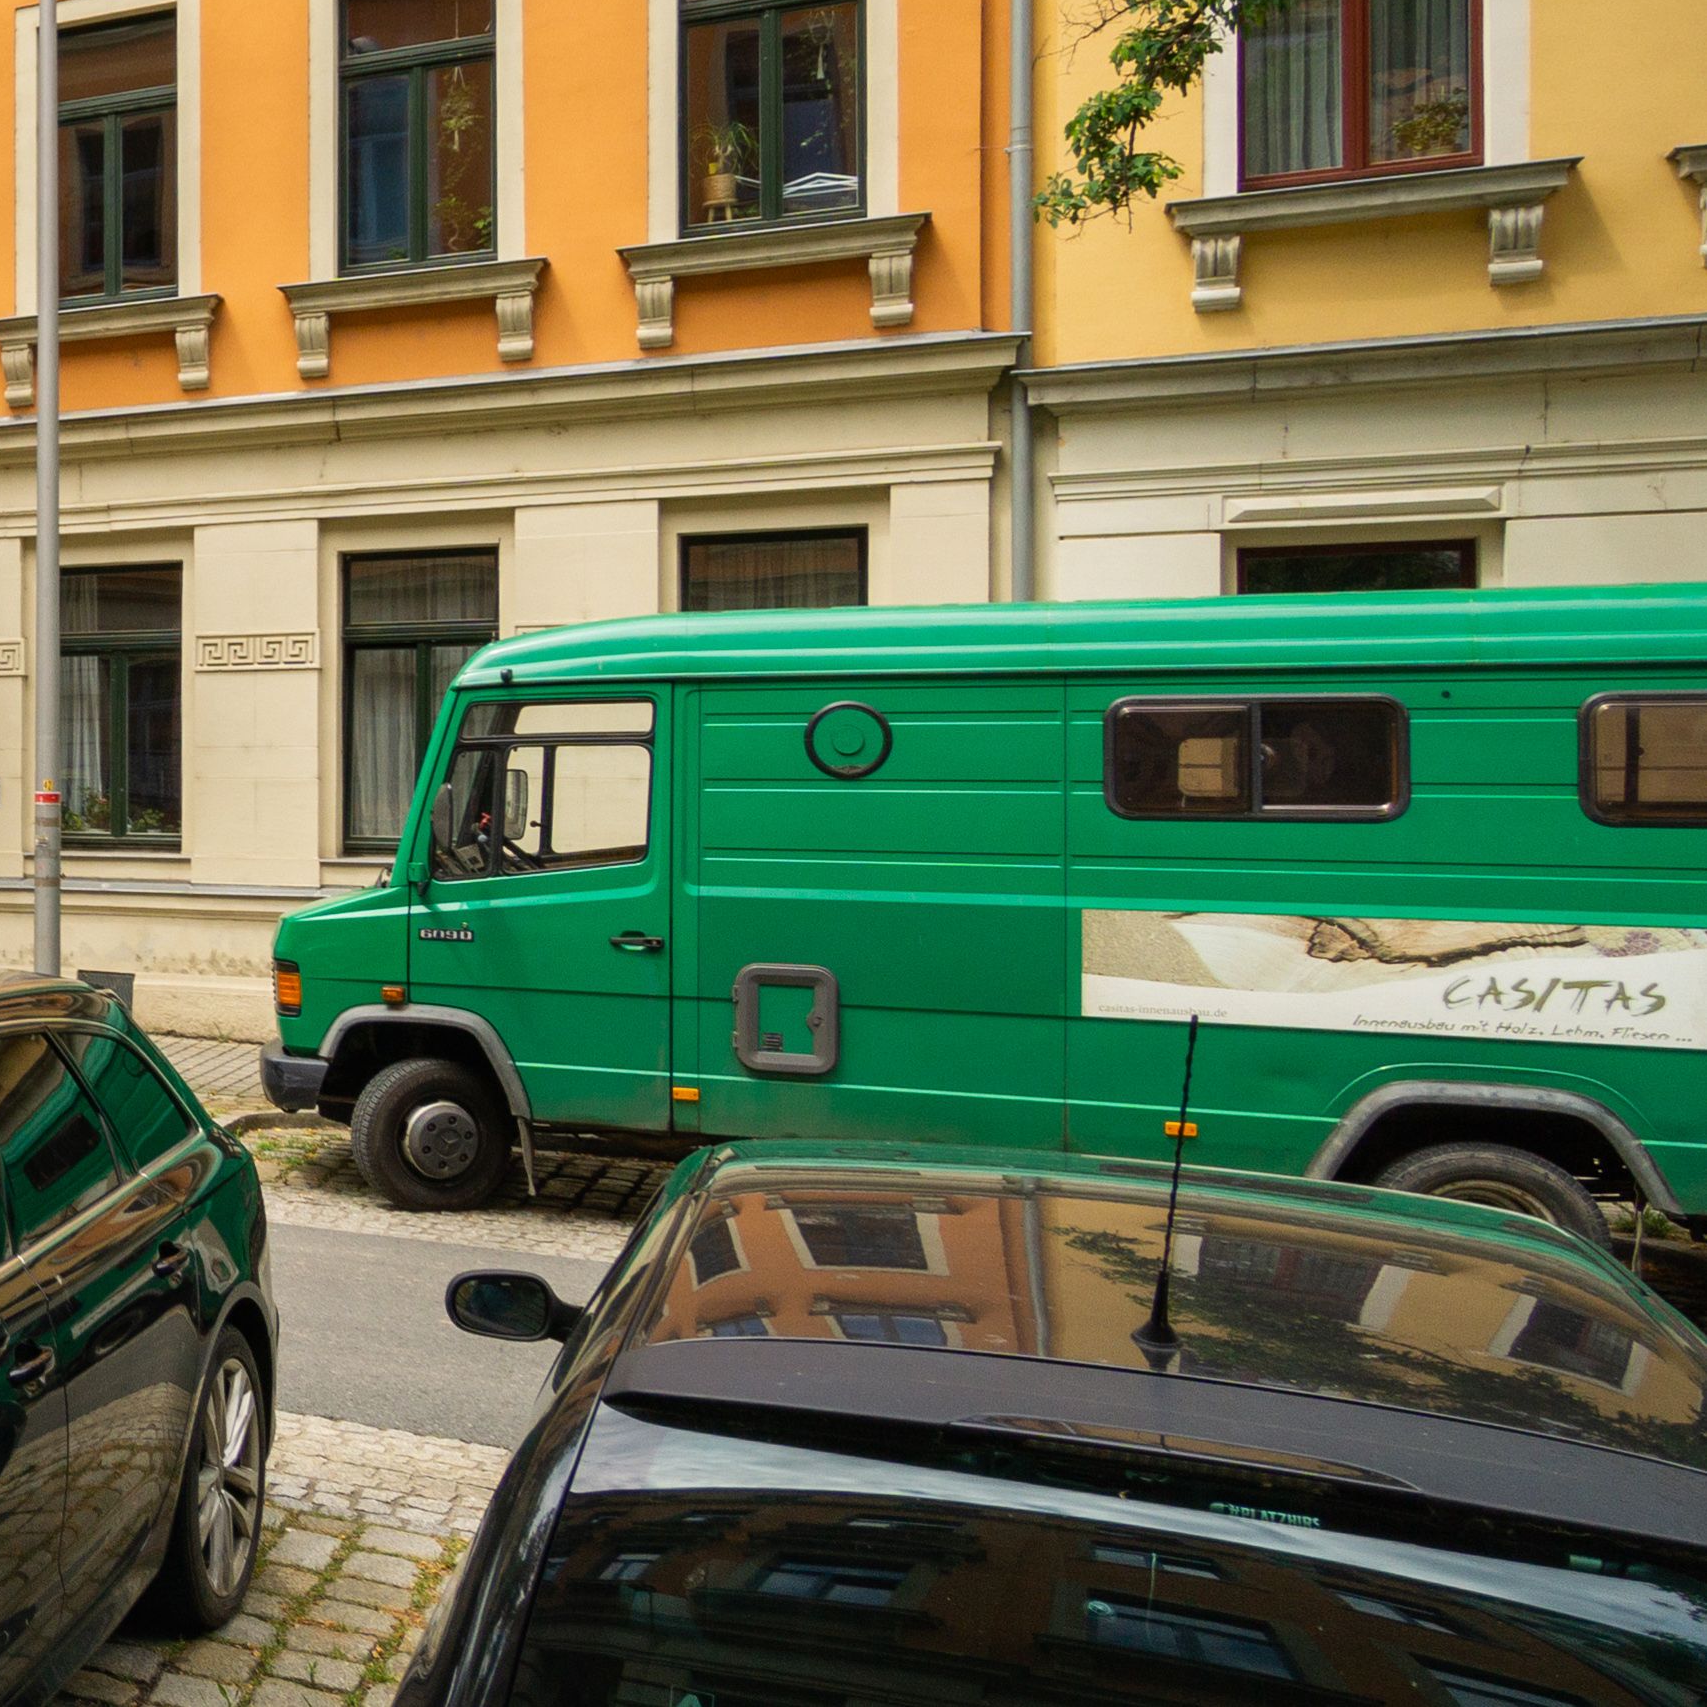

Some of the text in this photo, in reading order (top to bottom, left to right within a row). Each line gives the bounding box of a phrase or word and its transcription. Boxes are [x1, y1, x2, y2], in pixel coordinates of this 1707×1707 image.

[1442, 976, 1666, 1017] CASITAS
[1098, 1003, 1228, 1019] casitas-innenausbau.de
[1352, 1014, 1455, 1031] Innenausbau
[1461, 1020, 1488, 1033] mit
